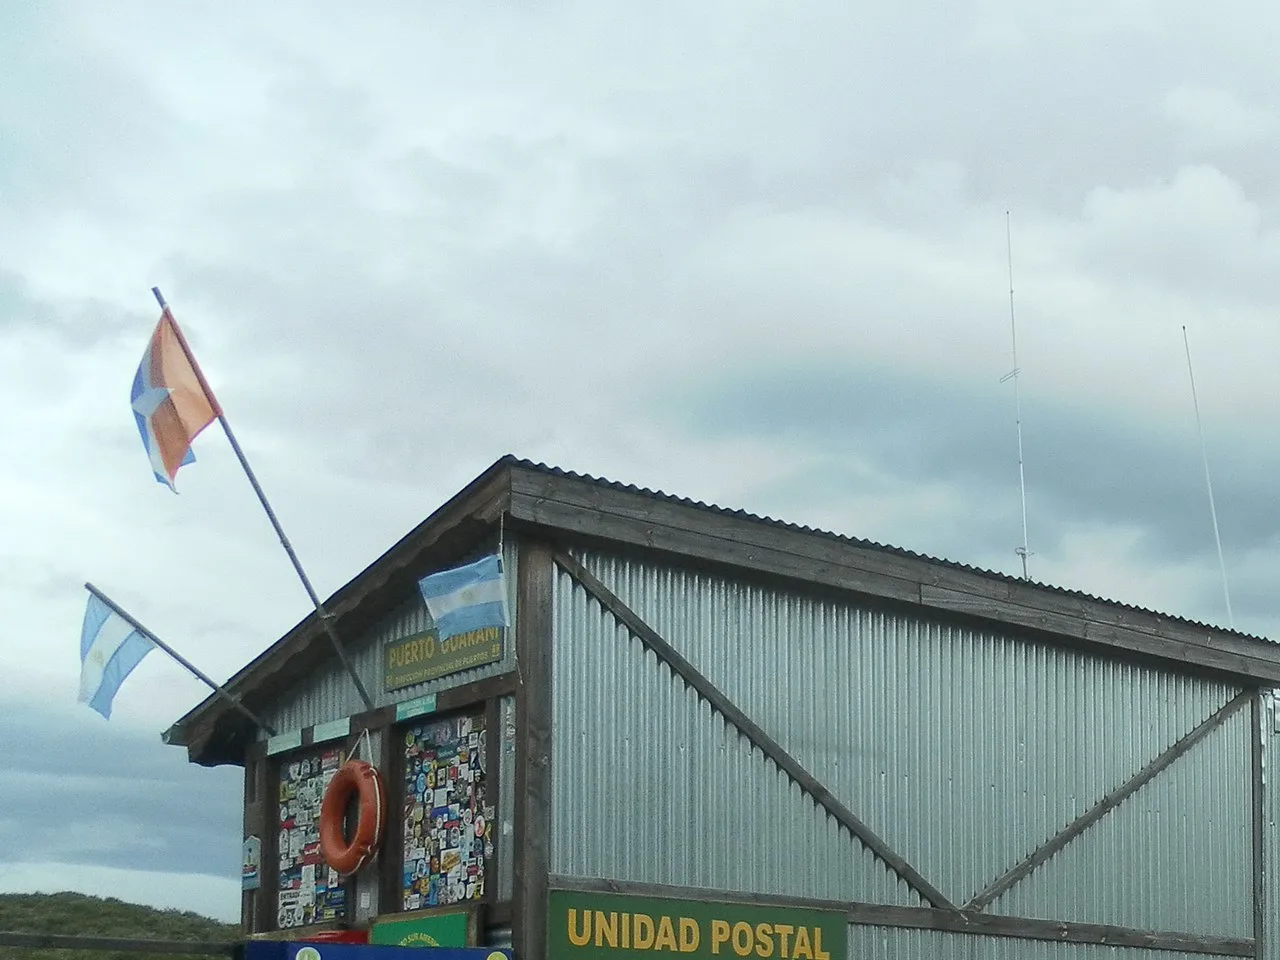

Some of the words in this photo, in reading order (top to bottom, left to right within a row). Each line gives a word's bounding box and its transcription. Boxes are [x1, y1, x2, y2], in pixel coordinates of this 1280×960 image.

[388, 636, 435, 669] PUERTO
[567, 908, 700, 953] UNIDAD
[711, 919, 830, 960] POSTAL
